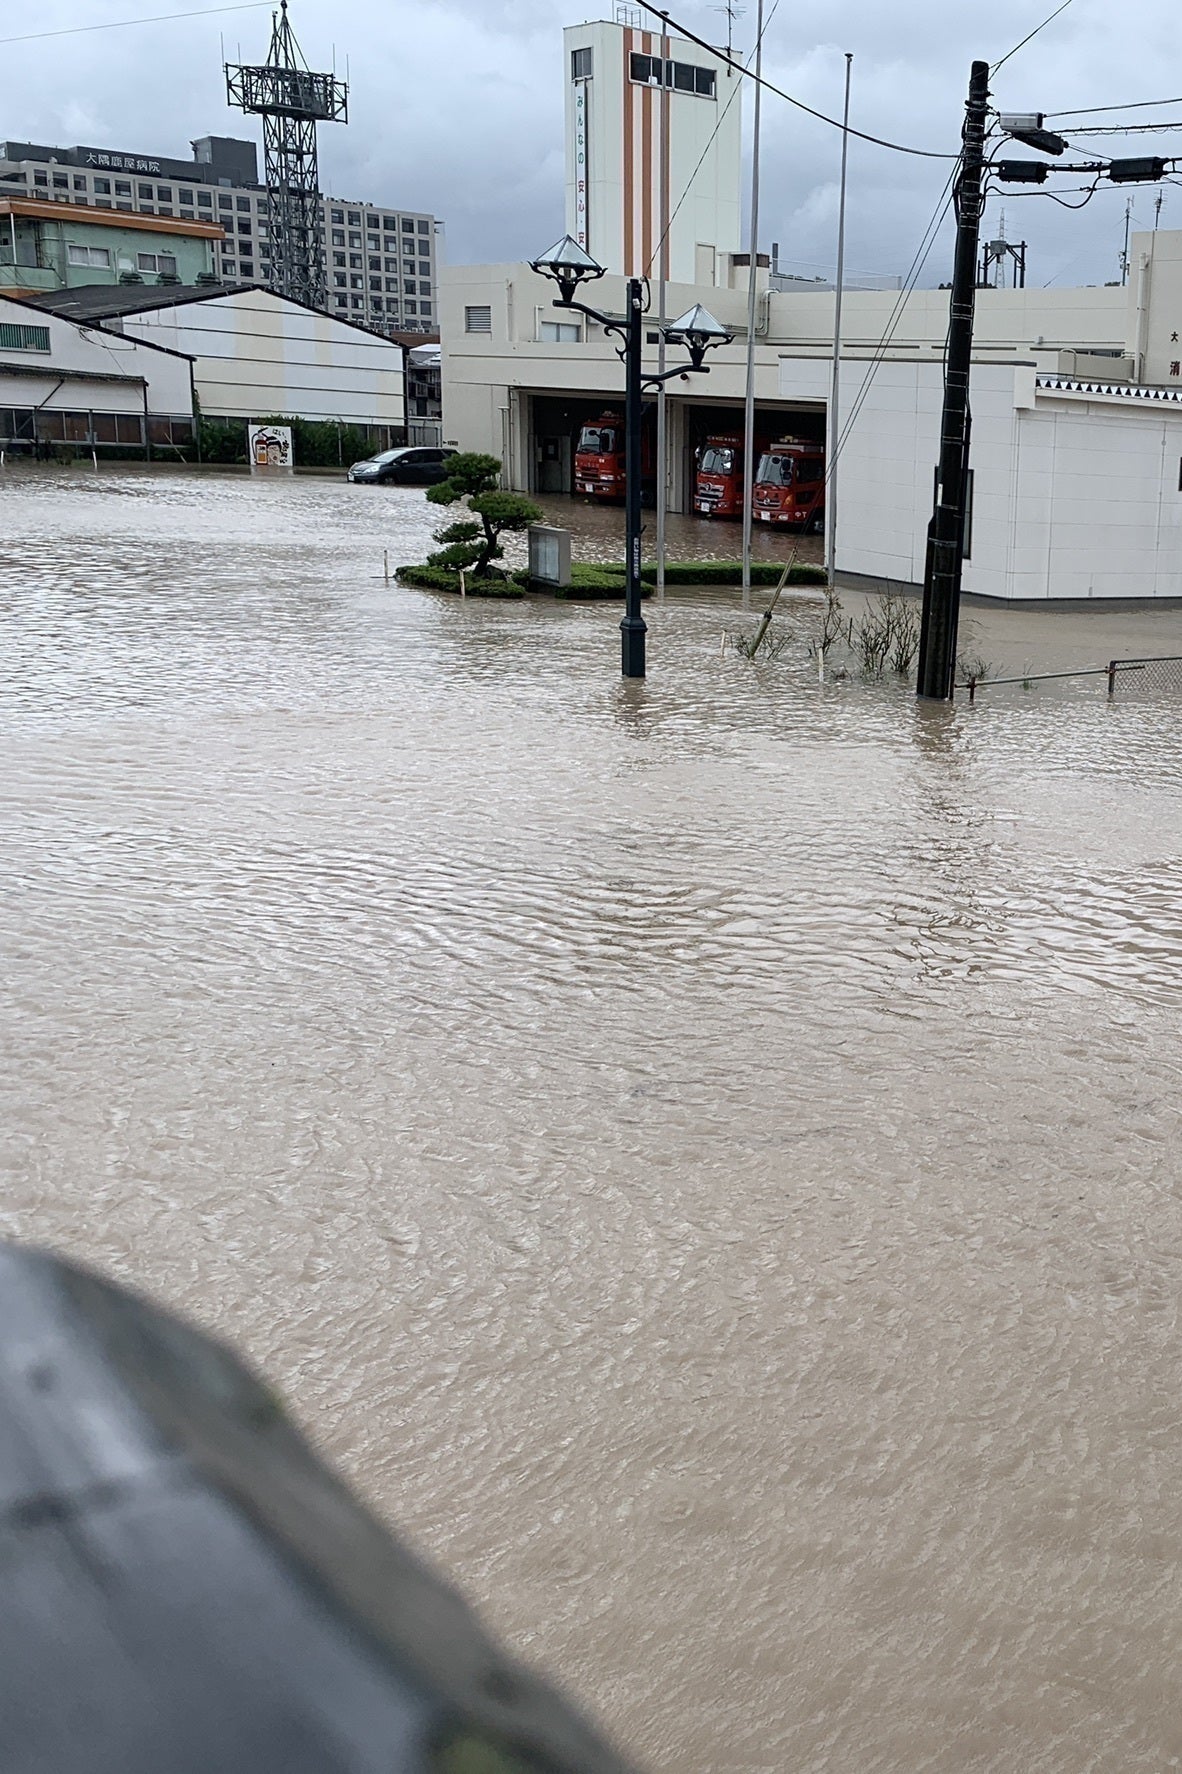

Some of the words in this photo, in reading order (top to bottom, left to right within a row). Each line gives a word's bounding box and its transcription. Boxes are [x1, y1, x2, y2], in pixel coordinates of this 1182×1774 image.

[86, 152, 161, 173] 大隅鹿屋病院
